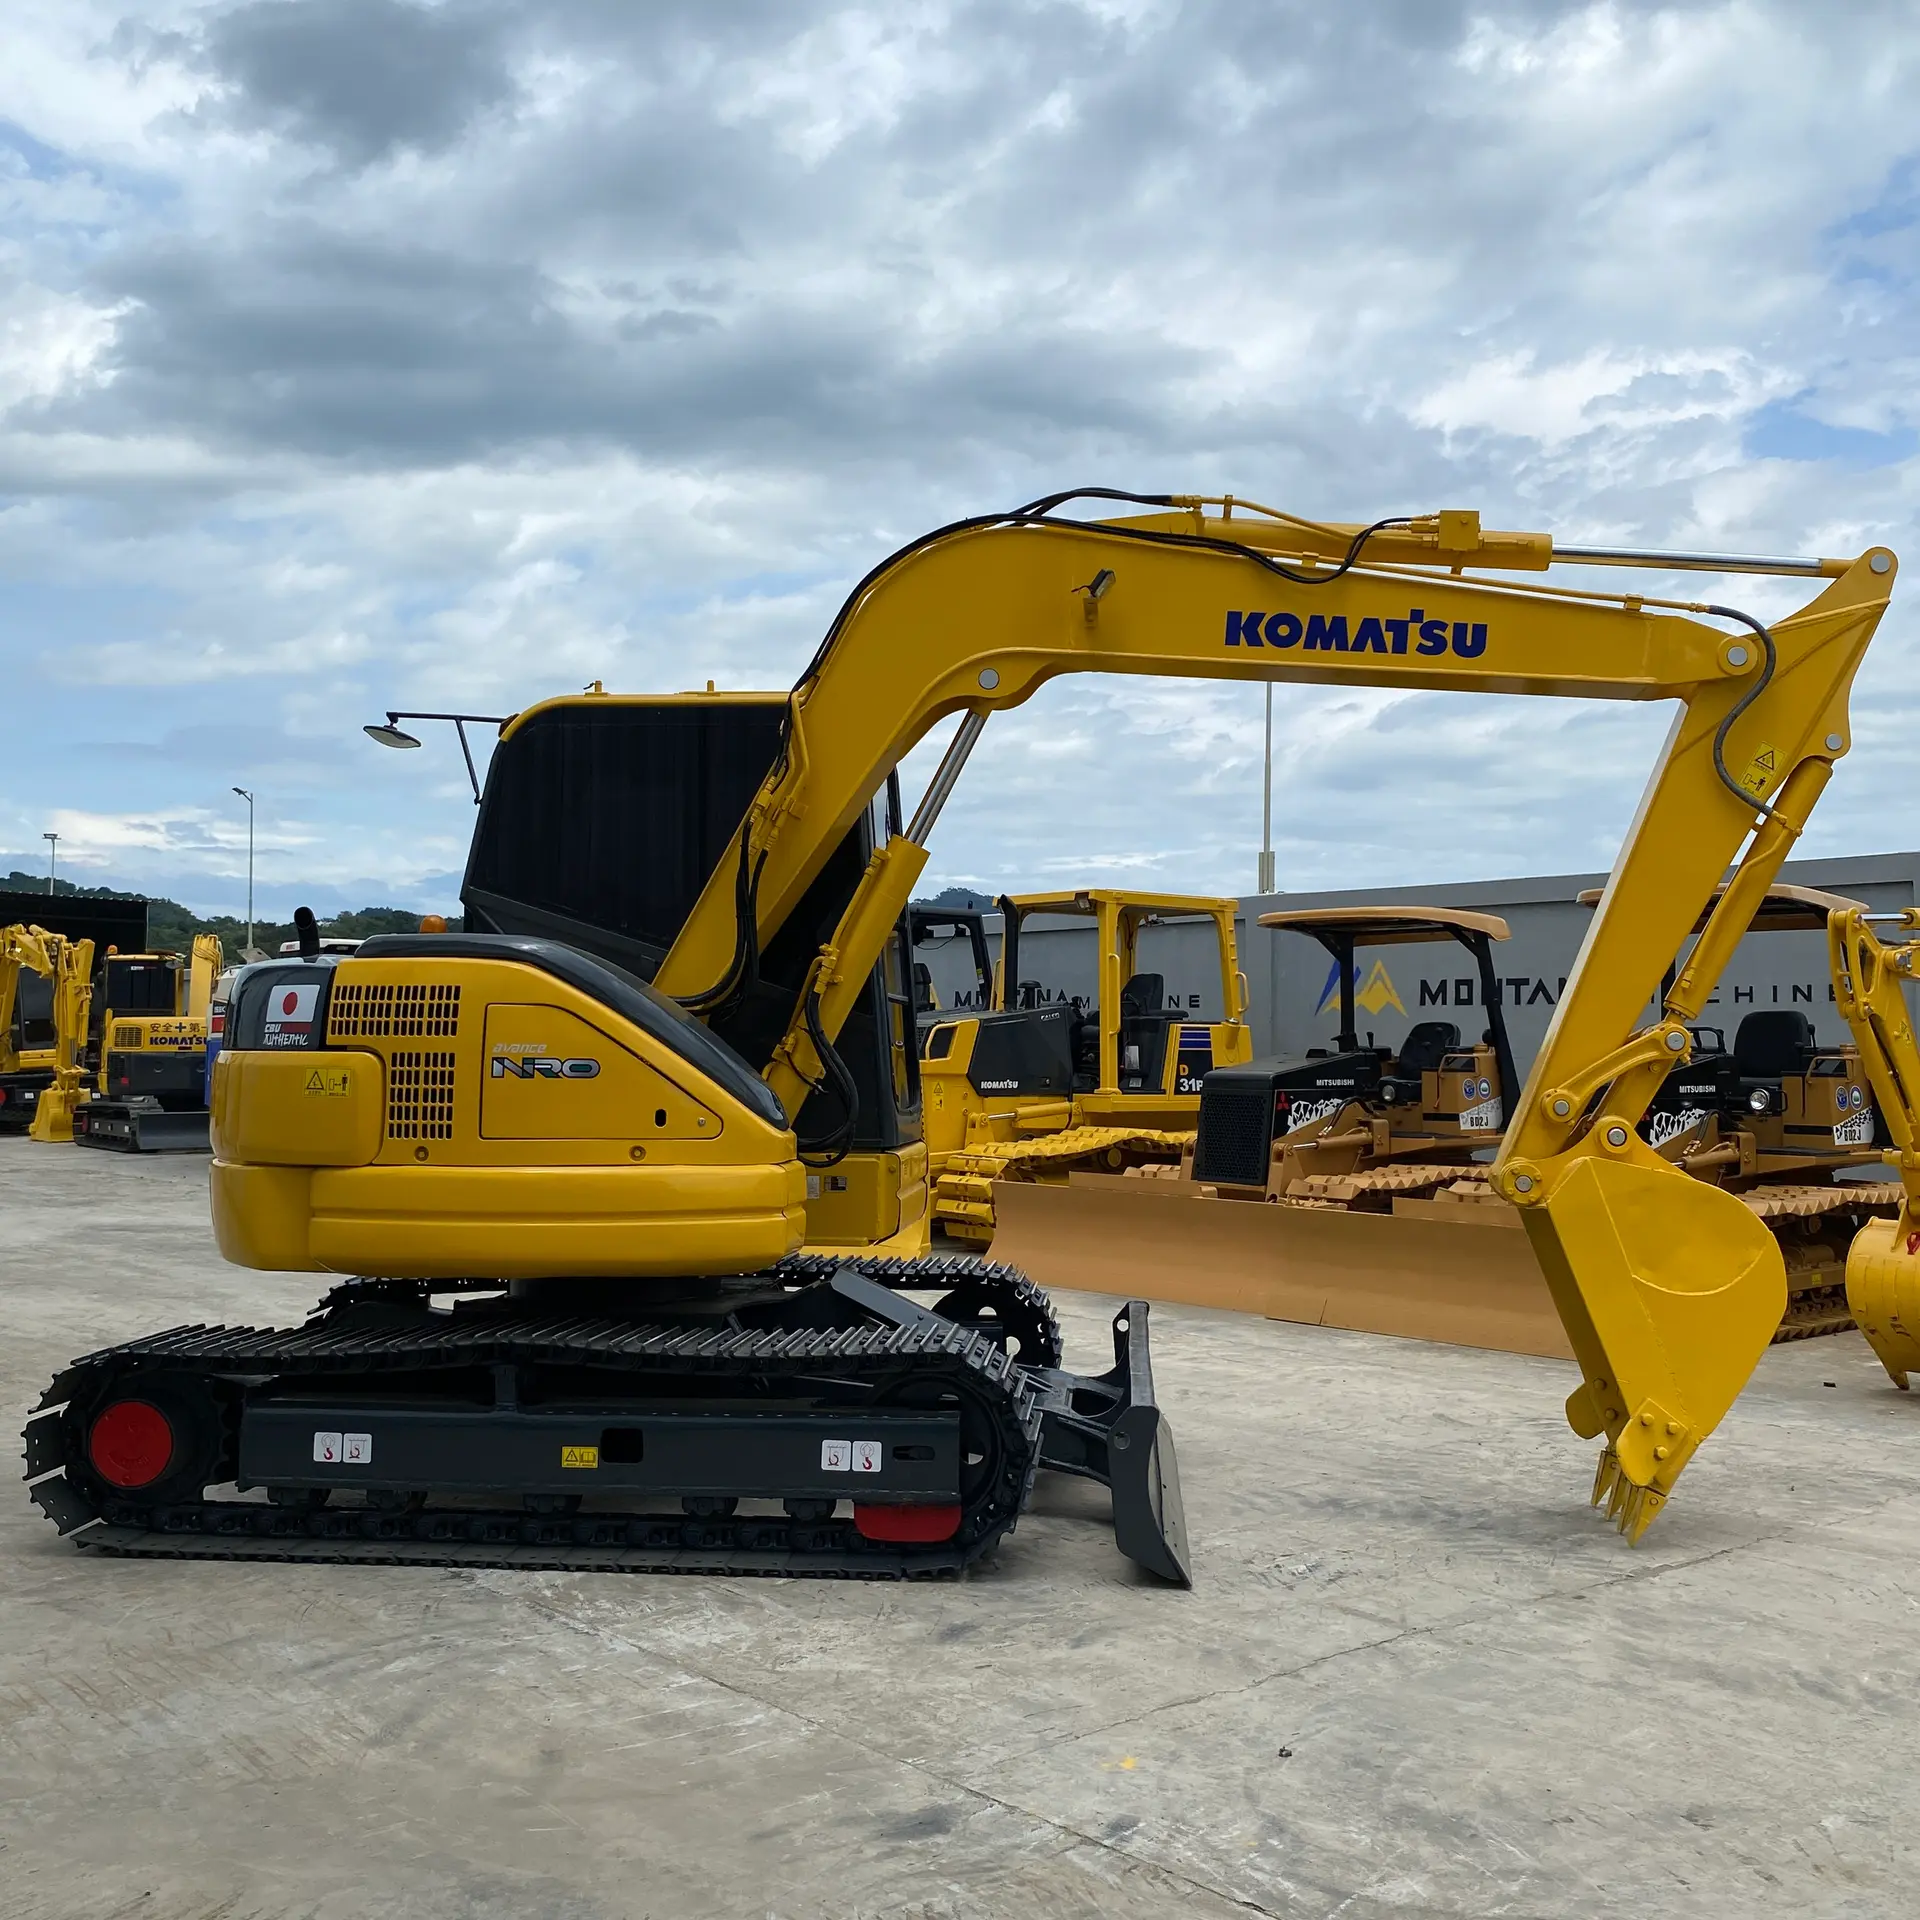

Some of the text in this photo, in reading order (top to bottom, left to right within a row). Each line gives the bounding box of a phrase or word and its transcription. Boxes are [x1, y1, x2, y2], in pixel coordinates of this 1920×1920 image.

[1225, 609, 1488, 658] KOMATSU
[264, 1024, 281, 1032] CBU
[981, 1079, 1019, 1089] KOMATSU
[1679, 1085, 1716, 1093] MITSUBISHI
